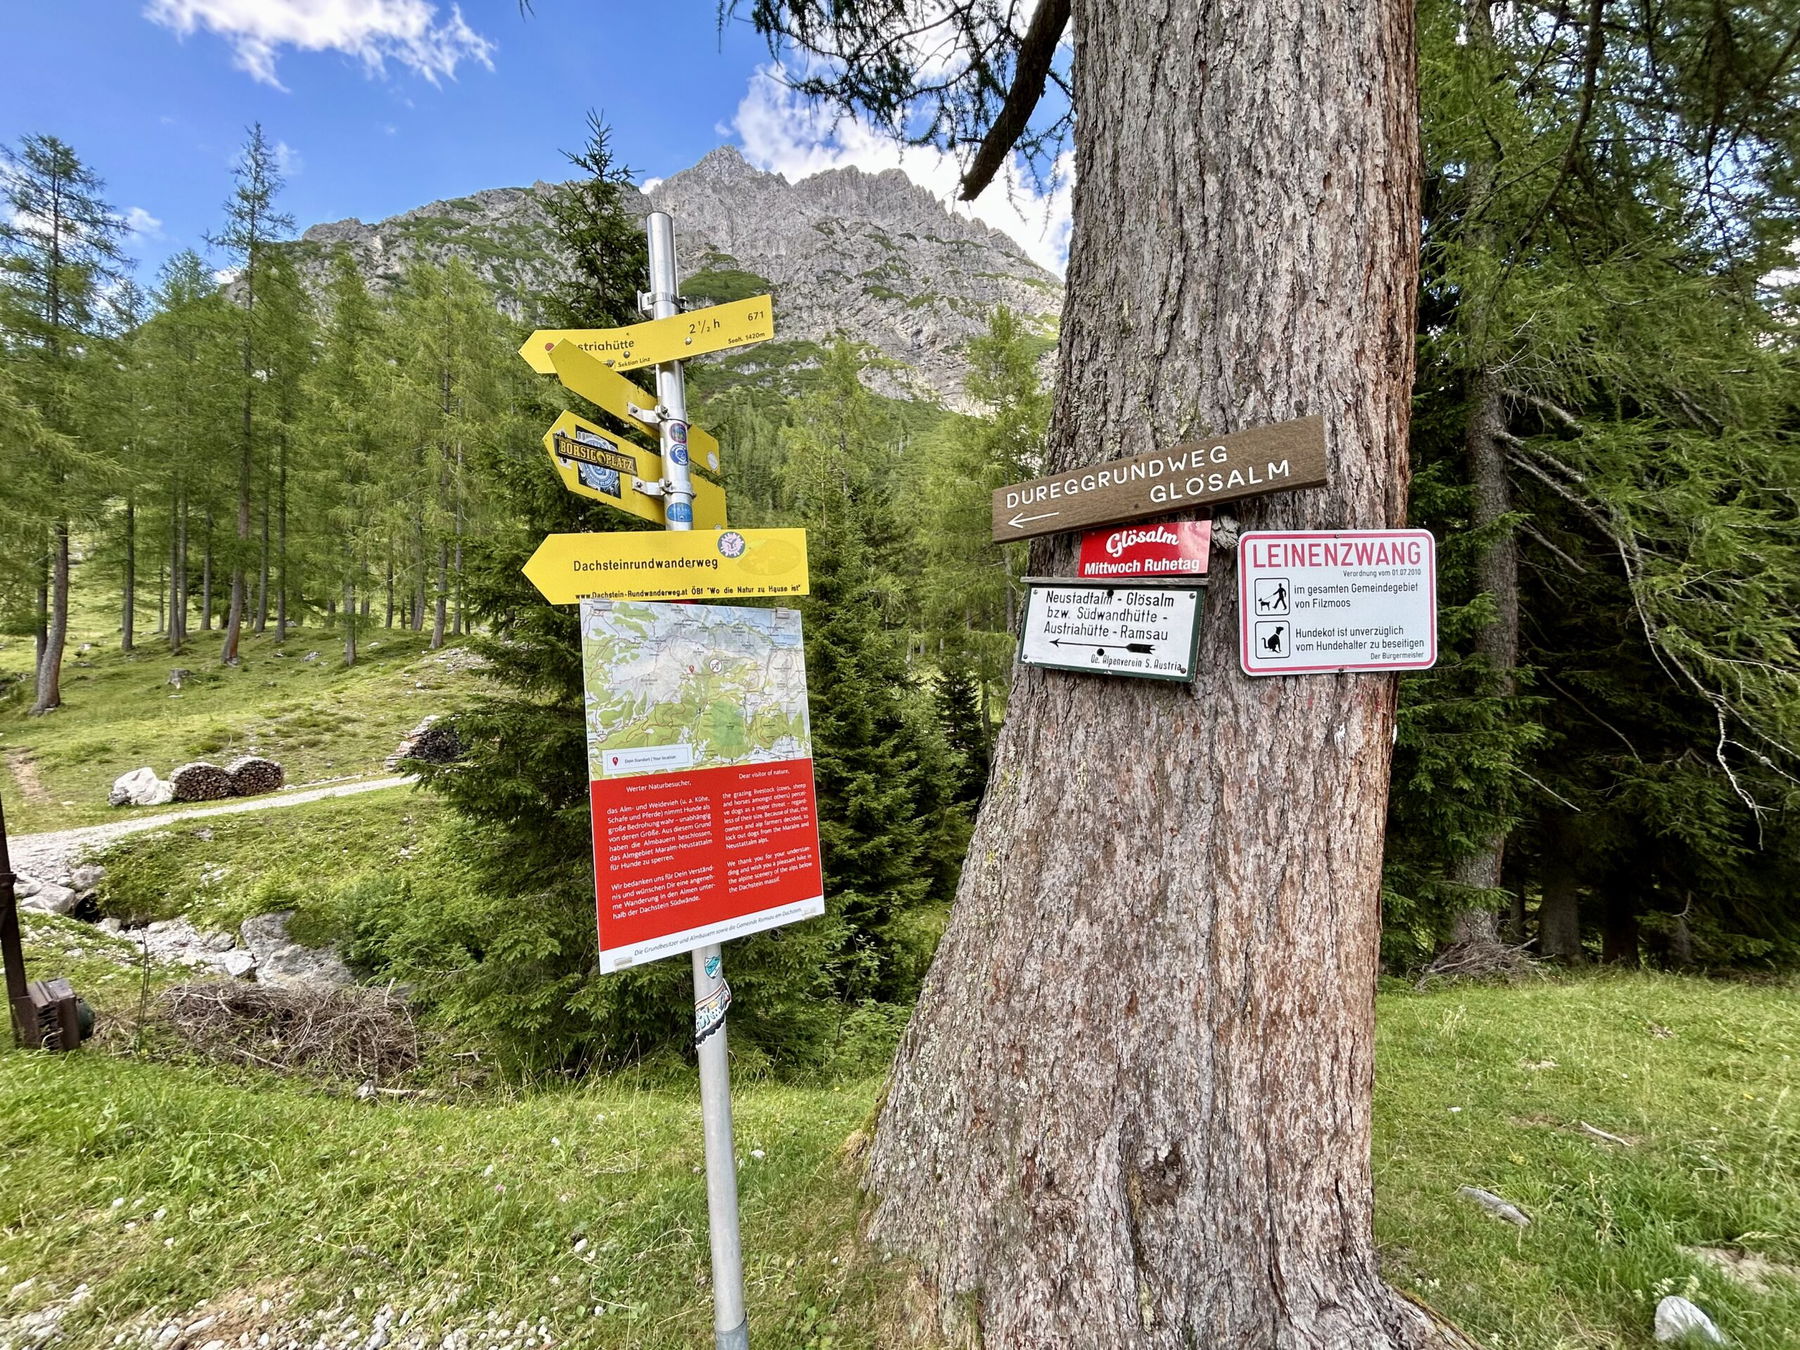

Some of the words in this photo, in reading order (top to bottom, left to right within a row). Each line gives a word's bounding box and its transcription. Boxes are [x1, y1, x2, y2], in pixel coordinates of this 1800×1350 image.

[748, 311, 764, 321] 671
[745, 332, 765, 341] 1420m
[577, 339, 635, 352] striahütte
[617, 360, 639, 368] Sektion
[1006, 445, 1228, 508] DUREGGRUNDWEG
[1150, 459, 1289, 502] GLÖSALM
[1105, 525, 1179, 558] Glösalm
[1252, 541, 1421, 568] LEINENZWANG
[573, 557, 718, 571] Dachsteinrundwanderweg
[1084, 559, 1141, 575] Mittwoch
[1144, 557, 1199, 572] Ruhetag
[1343, 570, 1377, 578] Verordnung
[1392, 568, 1421, 576] 01.07.2010
[1294, 585, 1305, 594] im
[1307, 584, 1349, 597] gesamten
[1351, 582, 1418, 595] Gemeindegebiet
[1046, 590, 1113, 605] Neustadtalm
[1126, 592, 1175, 607] Glösalm
[1313, 598, 1350, 608] Filzmoos
[1047, 606, 1070, 619] bzw.
[1077, 606, 1157, 623] Südwandhütte
[1044, 621, 1109, 637] Austriahütte
[1120, 624, 1168, 641] Ramsau
[1295, 628, 1335, 638] Hundekot
[1337, 627, 1348, 637] ist
[1350, 625, 1404, 639] unverzüglich
[1316, 640, 1367, 651] Hundehalter
[1370, 641, 1380, 649] zu
[1381, 638, 1424, 650] beseitigen
[1102, 654, 1142, 668] Alpenverein
[1145, 658, 1152, 668] S.
[1153, 659, 1181, 671] Austria
[649, 799, 679, 809] Weidevieh
[608, 816, 628, 824] Schafe
[642, 810, 664, 819] Pferde)
[664, 808, 683, 816] nimmt
[684, 805, 702, 813] Hunde
[608, 825, 626, 834] große
[627, 821, 660, 830] Bedrohung
[680, 813, 711, 822] unabhängig
[694, 821, 712, 829] Grund
[609, 844, 629, 852] haben
[644, 837, 676, 846] Almbauern
[622, 848, 653, 859] Almgebiet
[621, 860, 642, 869] Hunde
[611, 883, 623, 891] Wir
[624, 878, 653, 888] bedanken
[623, 890, 635, 898] und
[636, 885, 666, 895] wünschen
[624, 896, 659, 907] Wanderung
[613, 910, 627, 919] halb
[640, 902, 669, 913] Dachstein
